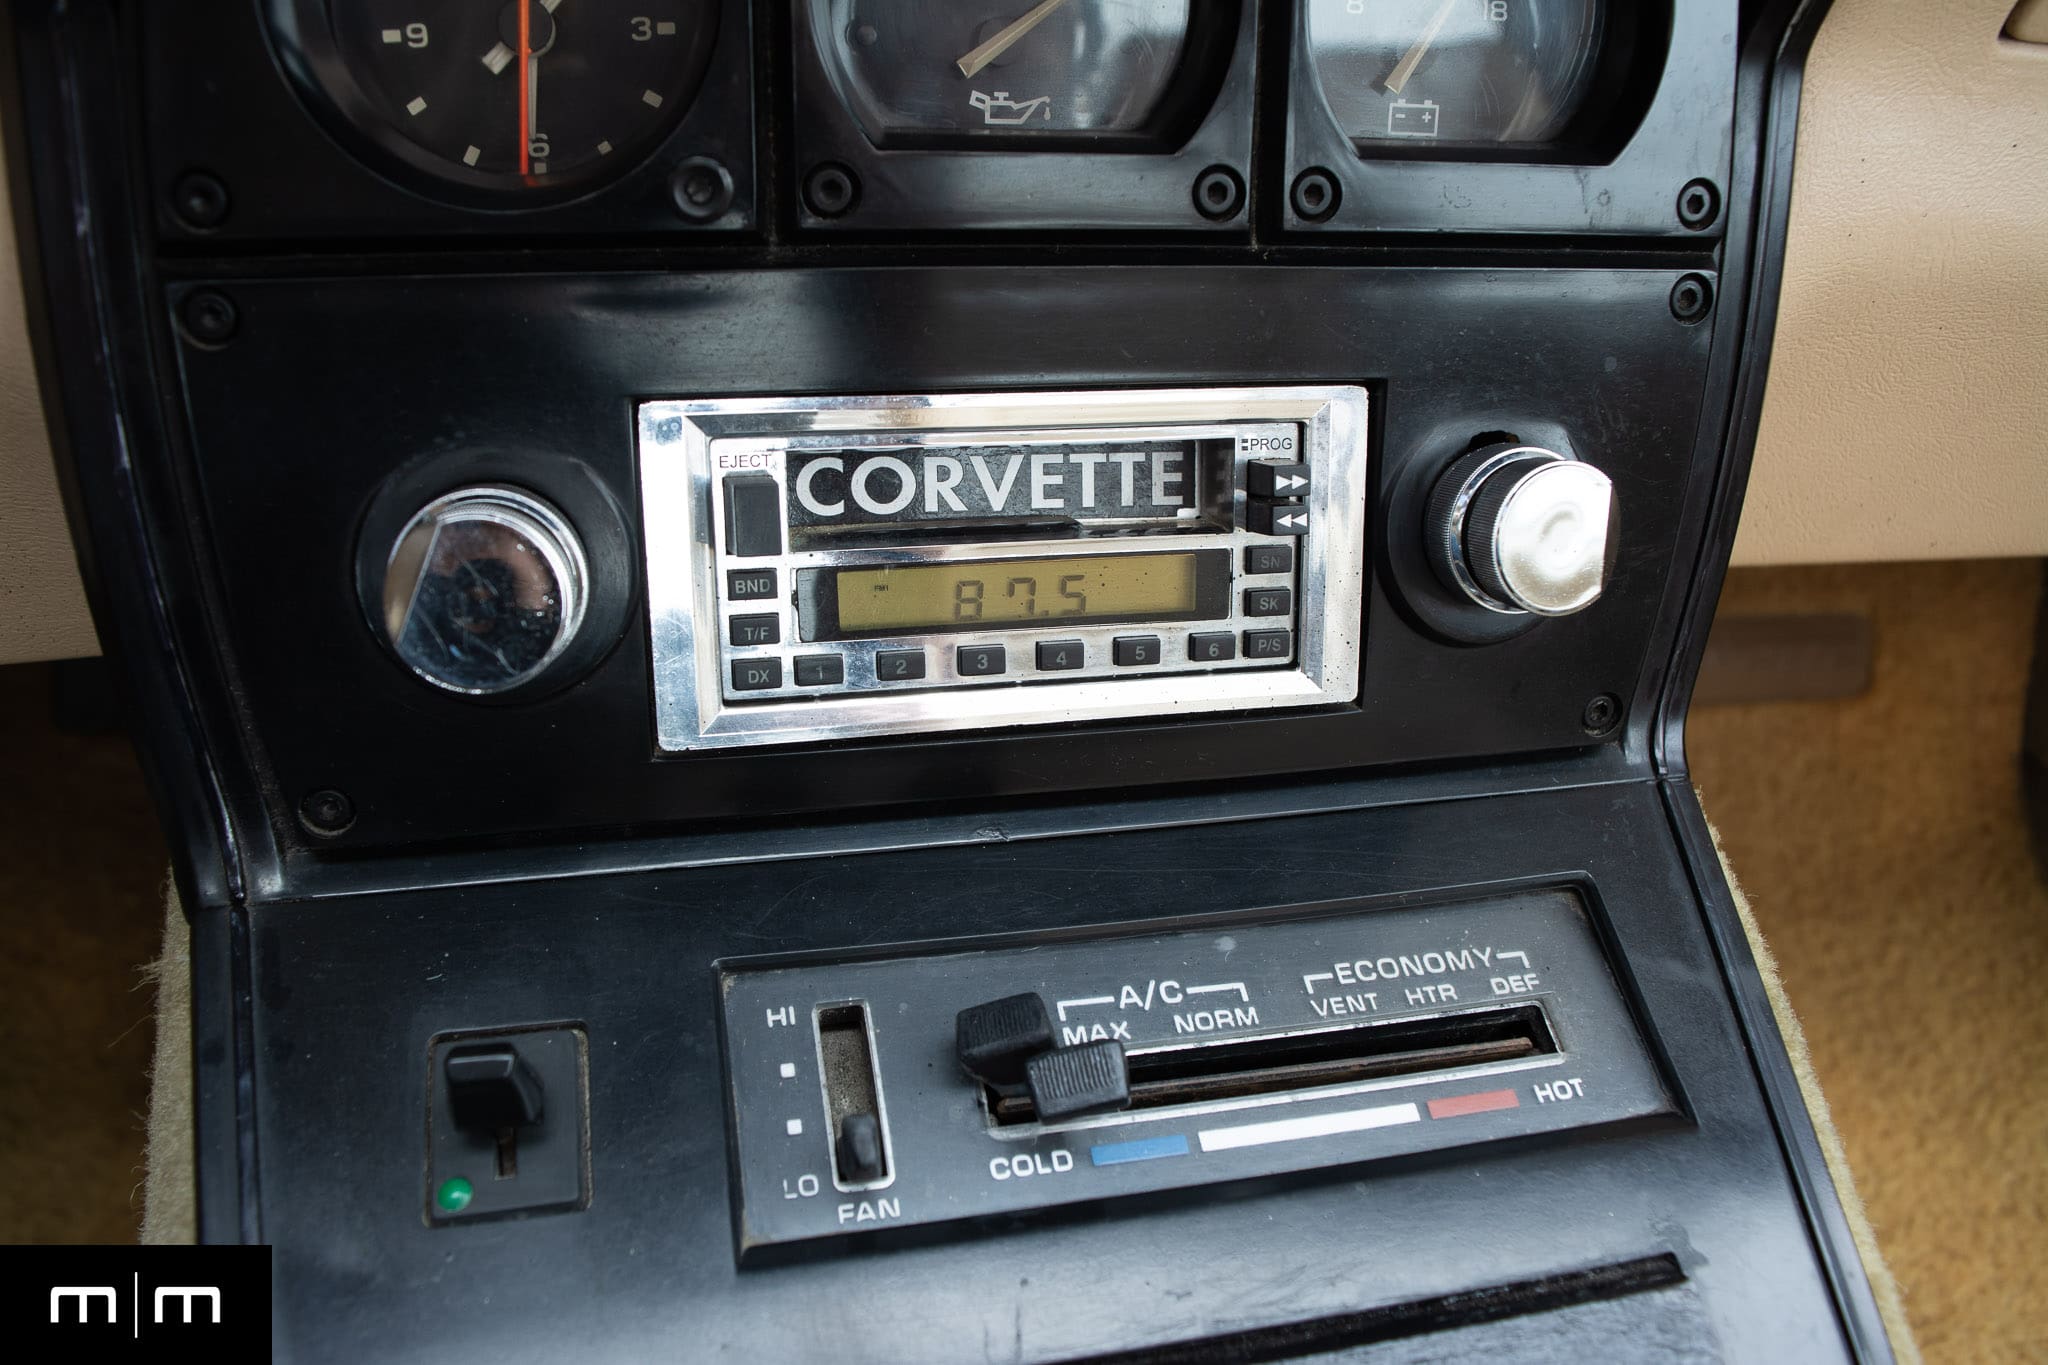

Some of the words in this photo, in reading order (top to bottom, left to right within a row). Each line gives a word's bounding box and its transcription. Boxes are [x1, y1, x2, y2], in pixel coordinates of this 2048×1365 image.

[405, 23, 428, 48] 9
[631, 17, 652, 41] 3
[527, 133, 550, 159] 6
[1250, 437, 1293, 451] PROG
[719, 454, 772, 469] EJECT
[796, 451, 1183, 516] CORVETTE
[1260, 555, 1280, 569] SN
[735, 578, 771, 594] BND
[955, 574, 1086, 621] 87.5
[1259, 597, 1279, 611] SK
[744, 626, 770, 641] T/F
[1135, 645, 1146, 661] 5
[1208, 643, 1220, 657] 6
[1258, 638, 1281, 652] P/S
[896, 659, 908, 675] 2
[976, 653, 989, 670] 3
[1056, 651, 1067, 666] 4
[748, 669, 770, 684] DX
[816, 665, 824, 681] 1
[1333, 946, 1492, 986] ECONOMY
[1119, 979, 1184, 1011] A/C
[1310, 992, 1379, 1017] VENT
[1404, 983, 1459, 1006] HTR
[1490, 973, 1540, 996] DEF
[766, 1006, 796, 1028] HI
[1061, 1021, 1132, 1047] MAX
[1173, 1006, 1260, 1034] NORM
[1533, 1078, 1585, 1104] HOT
[989, 1150, 1074, 1180] COLD
[783, 1174, 819, 1199] LO
[838, 1198, 901, 1224] FAN
